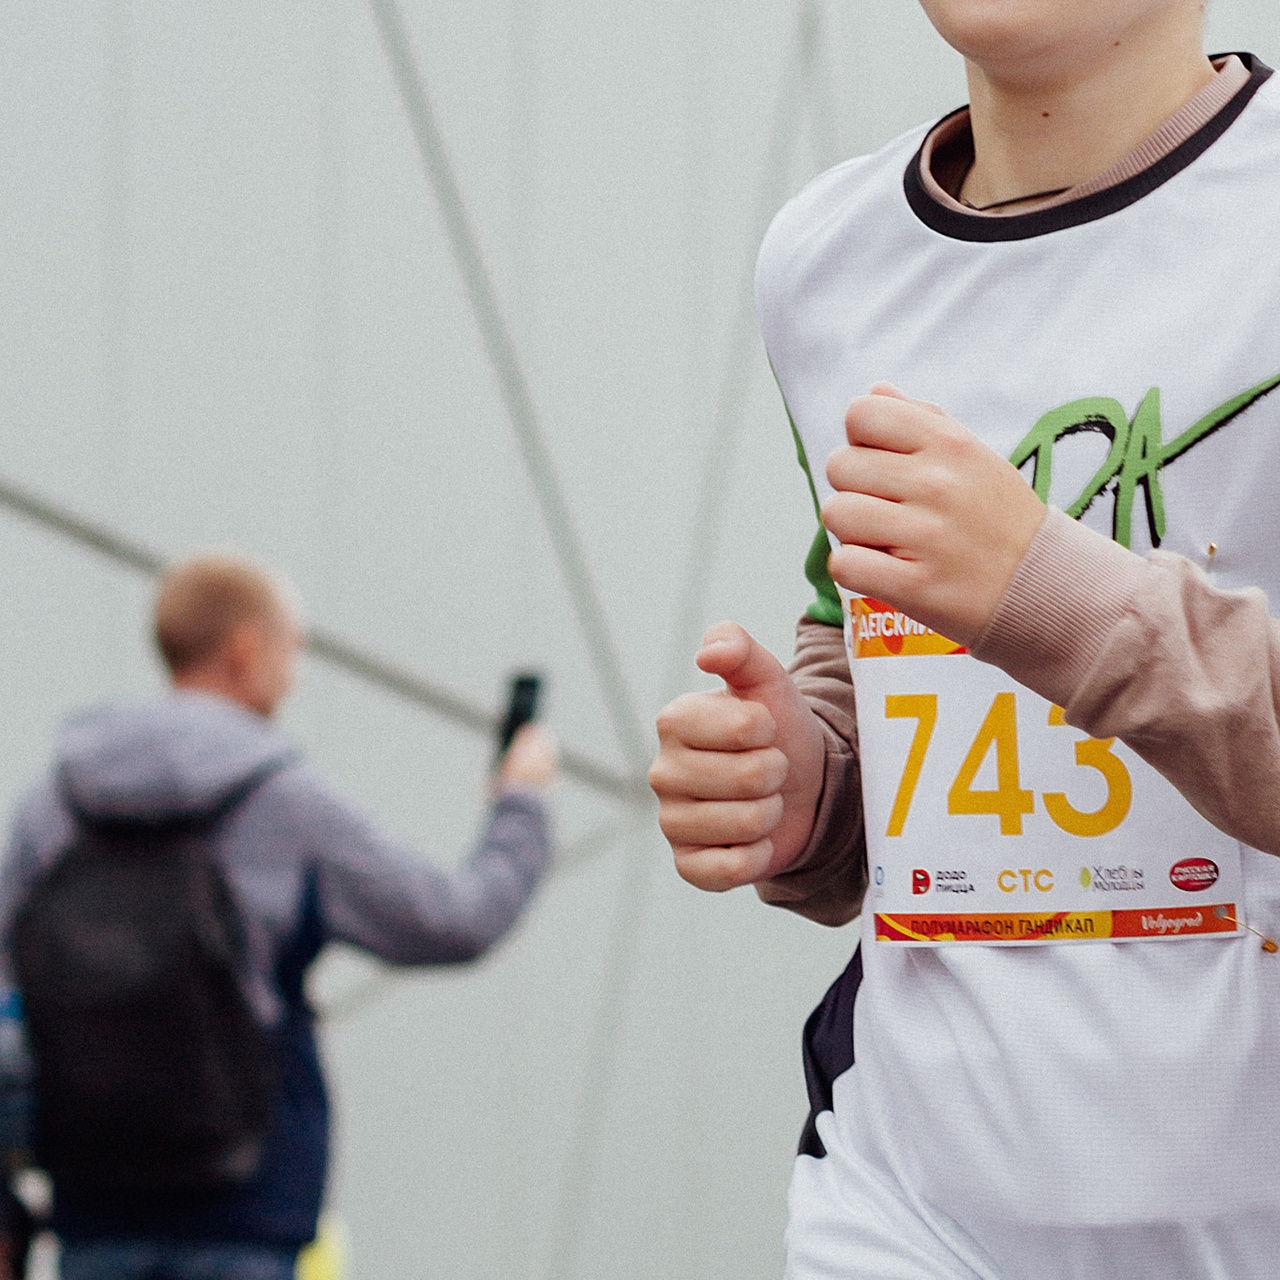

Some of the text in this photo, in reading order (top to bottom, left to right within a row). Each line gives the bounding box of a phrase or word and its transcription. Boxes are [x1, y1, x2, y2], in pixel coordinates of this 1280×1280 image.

[884, 692, 1132, 838] 743
[997, 869, 1055, 893] СТС
[910, 917, 1095, 936] ПОЛУМАРАФОН ГАНДИКАП
